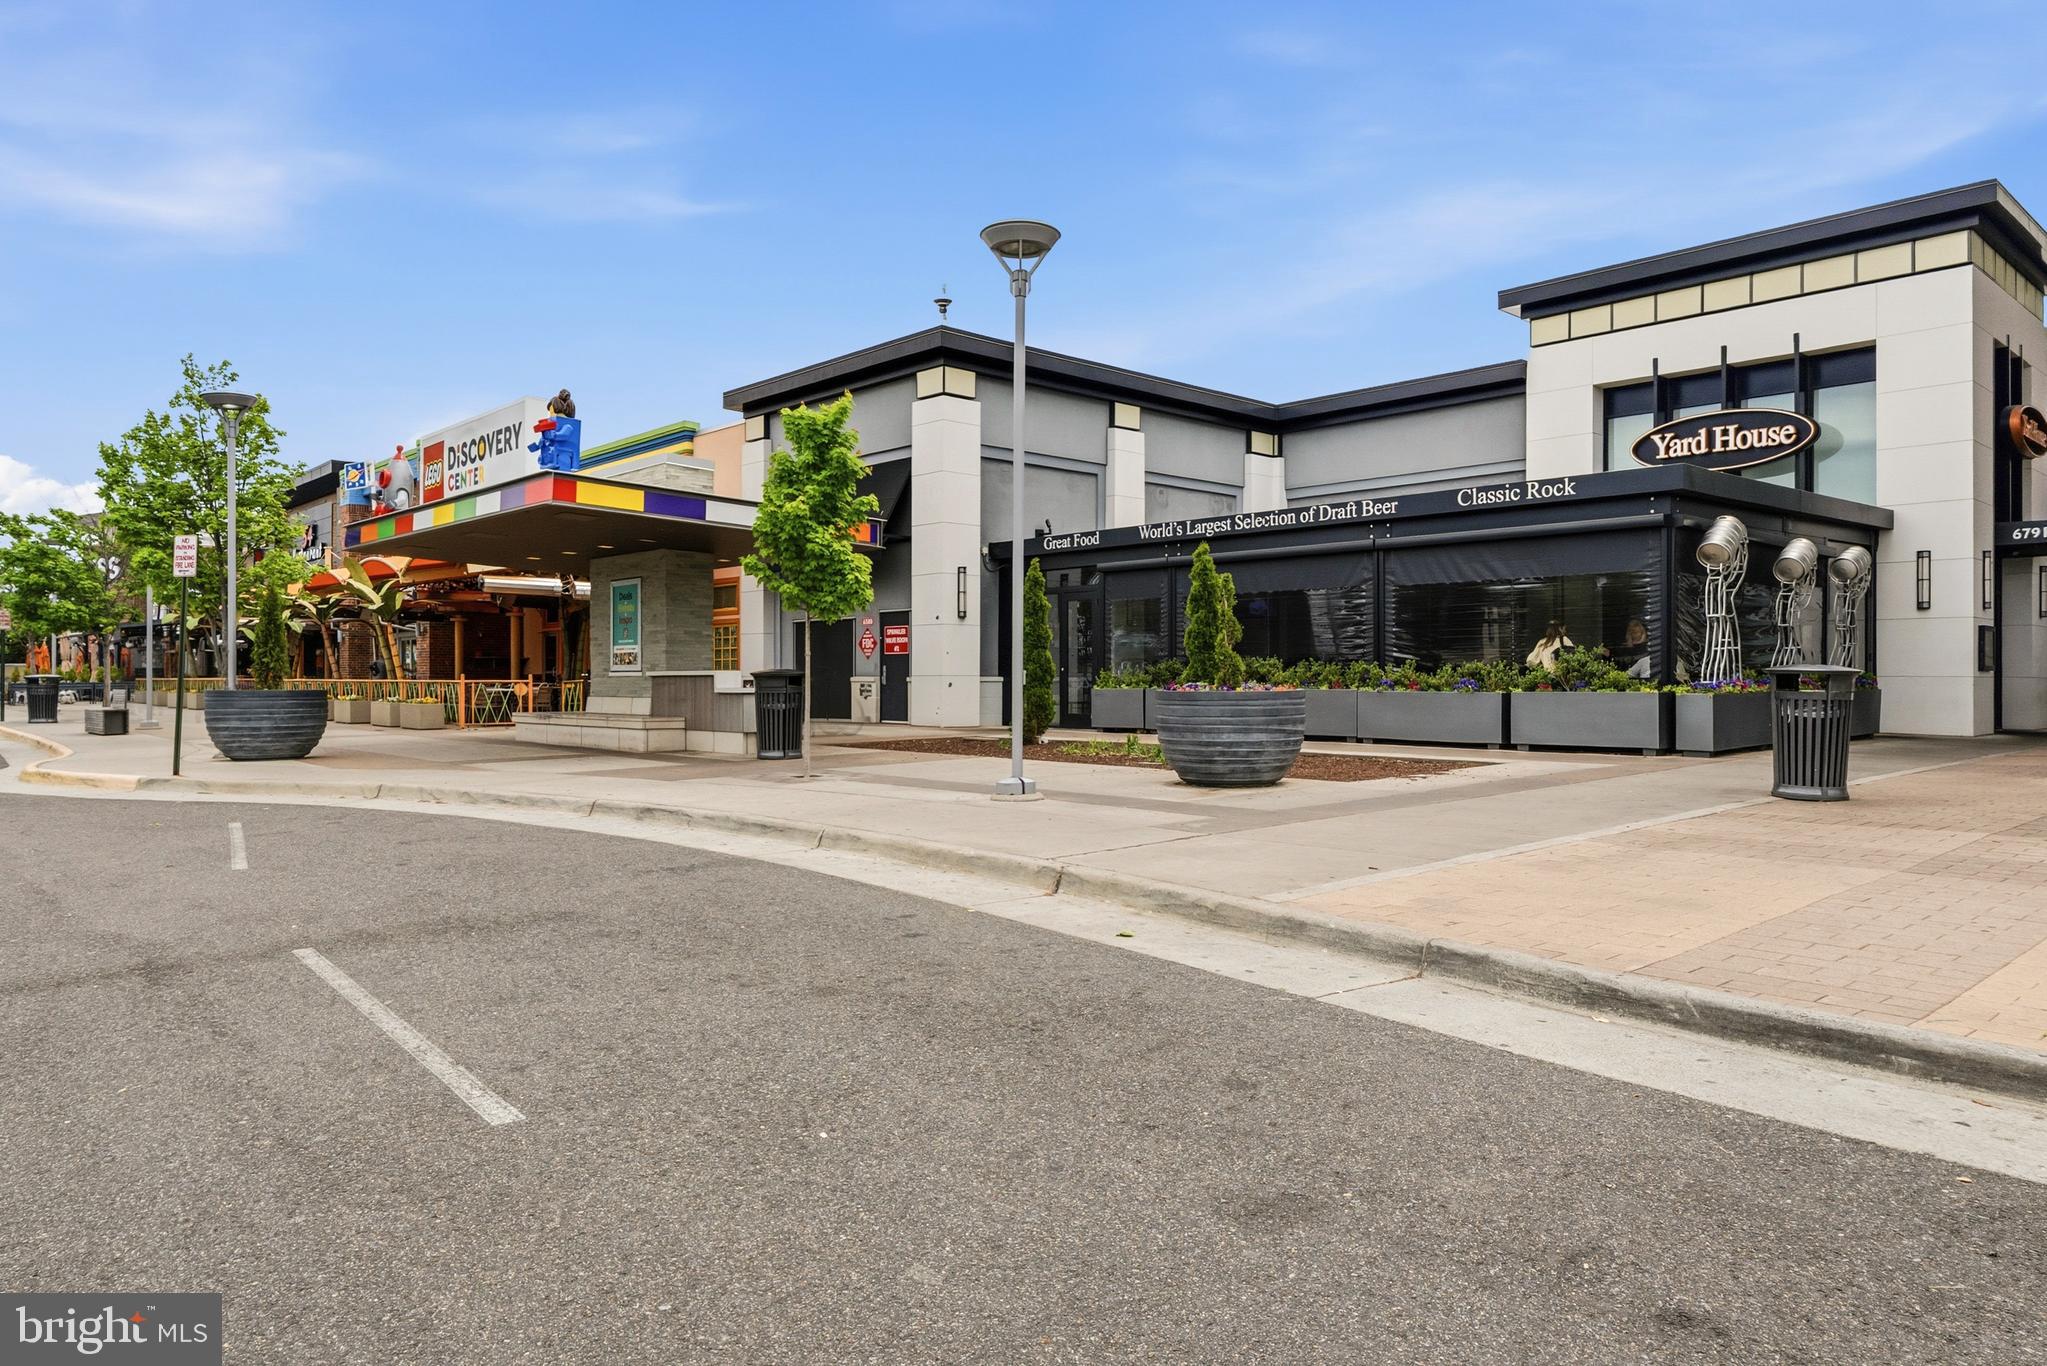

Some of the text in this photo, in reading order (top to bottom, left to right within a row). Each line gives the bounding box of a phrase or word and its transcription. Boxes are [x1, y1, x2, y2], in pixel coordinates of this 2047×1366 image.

[1650, 423, 1797, 460] Yard House
[424, 459, 443, 489] LEGO
[447, 463, 485, 491] CENTER
[1457, 477, 1576, 507] Classic Rock
[1138, 499, 1399, 540] World's Largest Selection of Draft Beer
[2012, 527, 2040, 540] 679
[181, 537, 190, 545] NO
[1043, 531, 1100, 551] Great Food
[861, 637, 874, 649] FDC
